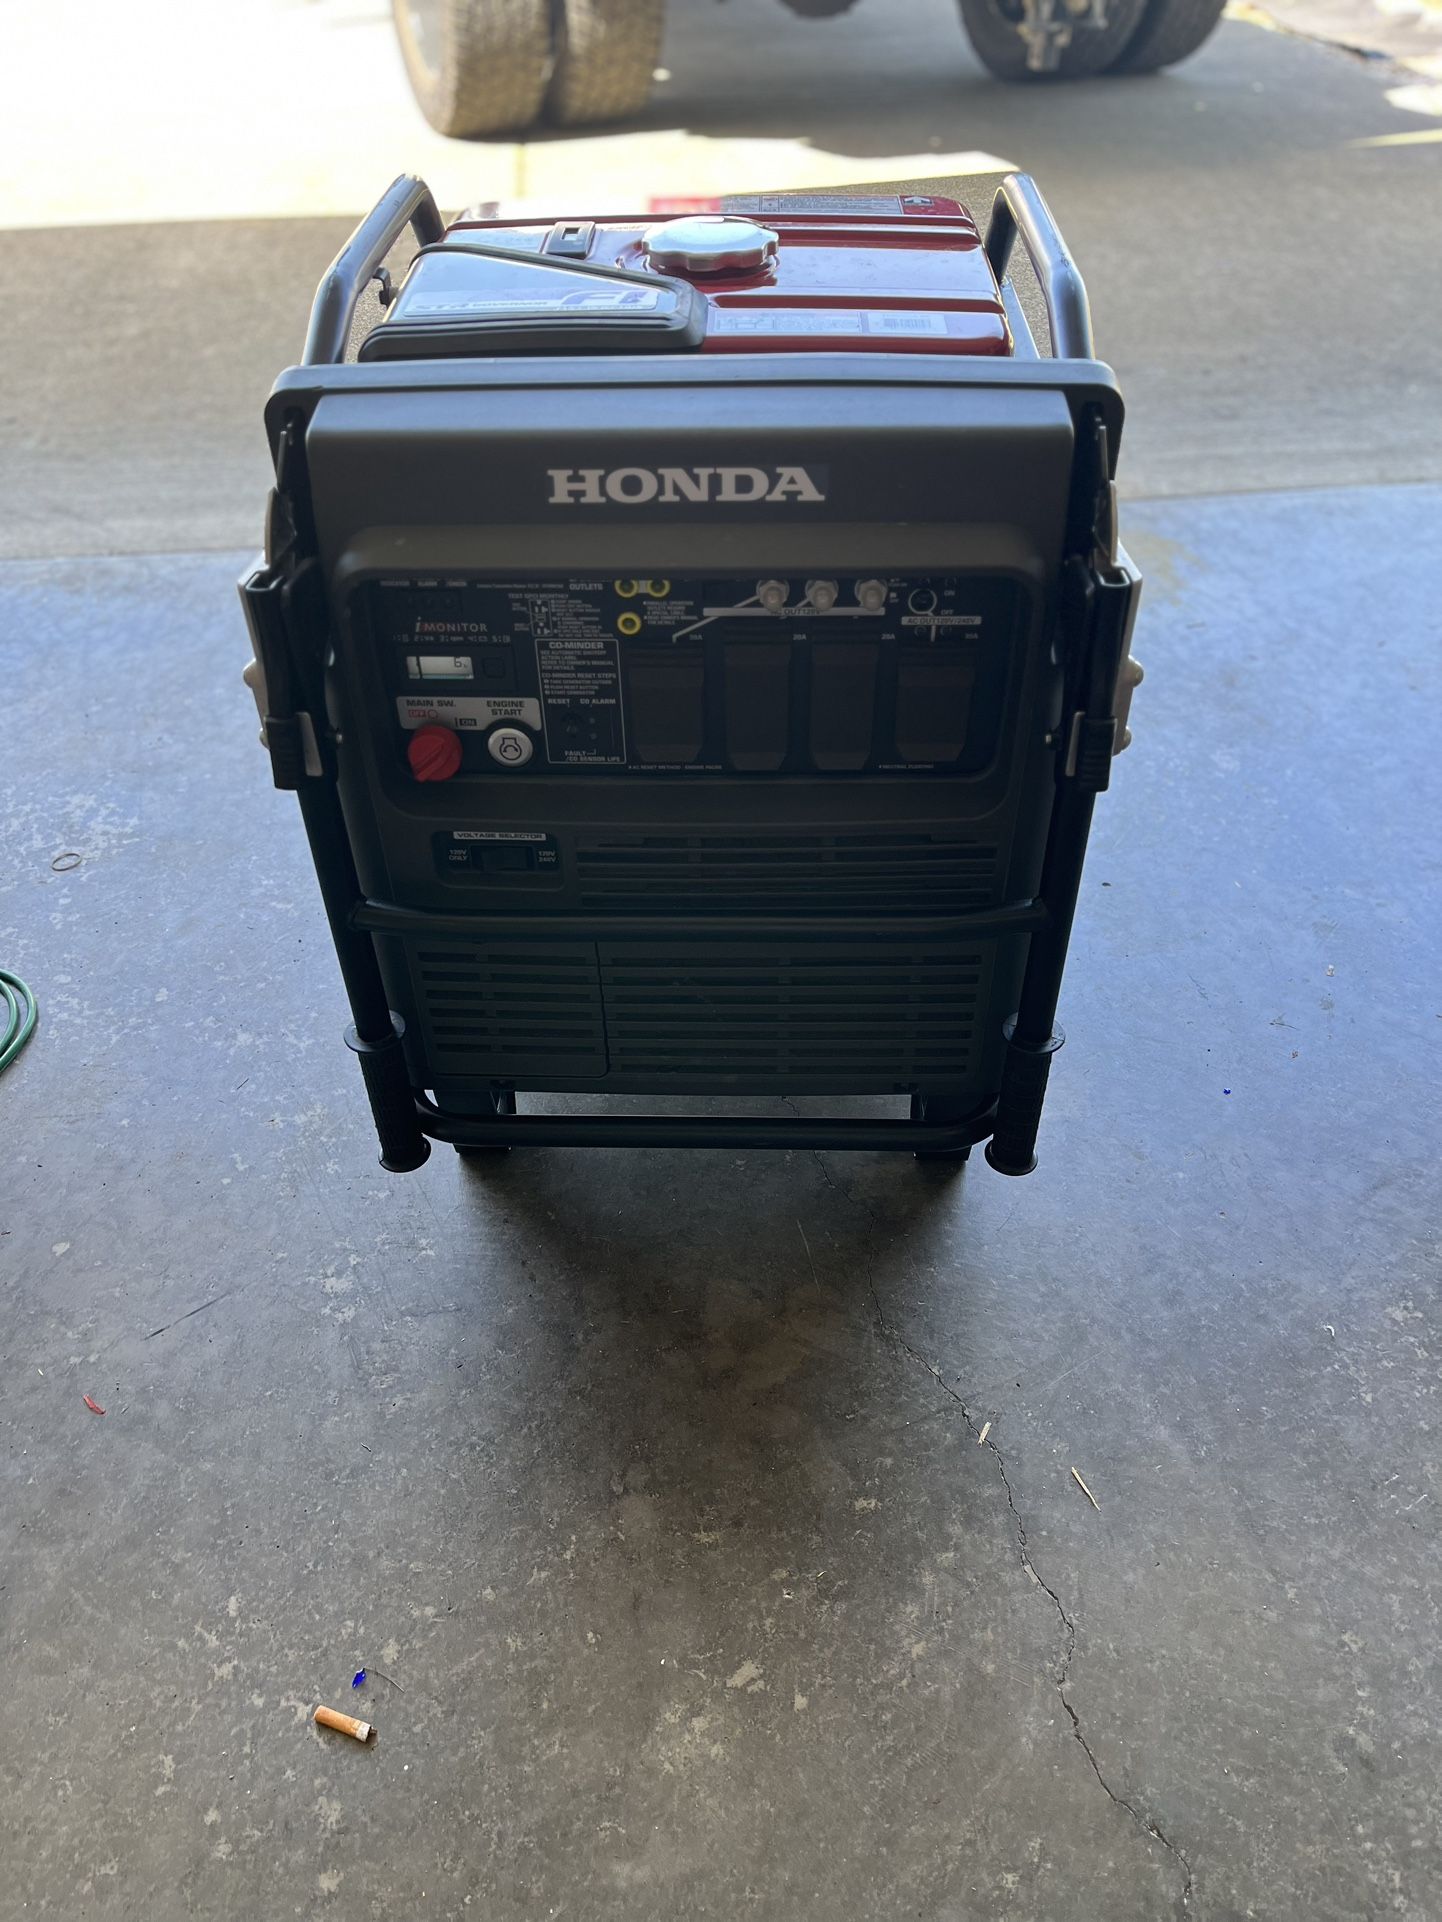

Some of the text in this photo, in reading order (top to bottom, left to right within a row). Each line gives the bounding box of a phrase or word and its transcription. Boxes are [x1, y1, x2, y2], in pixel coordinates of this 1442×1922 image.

[547, 467, 825, 504] HONDA
[549, 641, 604, 649] CO-MINDER
[407, 699, 434, 707] MAIN
[487, 700, 525, 708] ENGINE
[492, 708, 522, 716] START
[498, 832, 543, 840] SELECTOR
